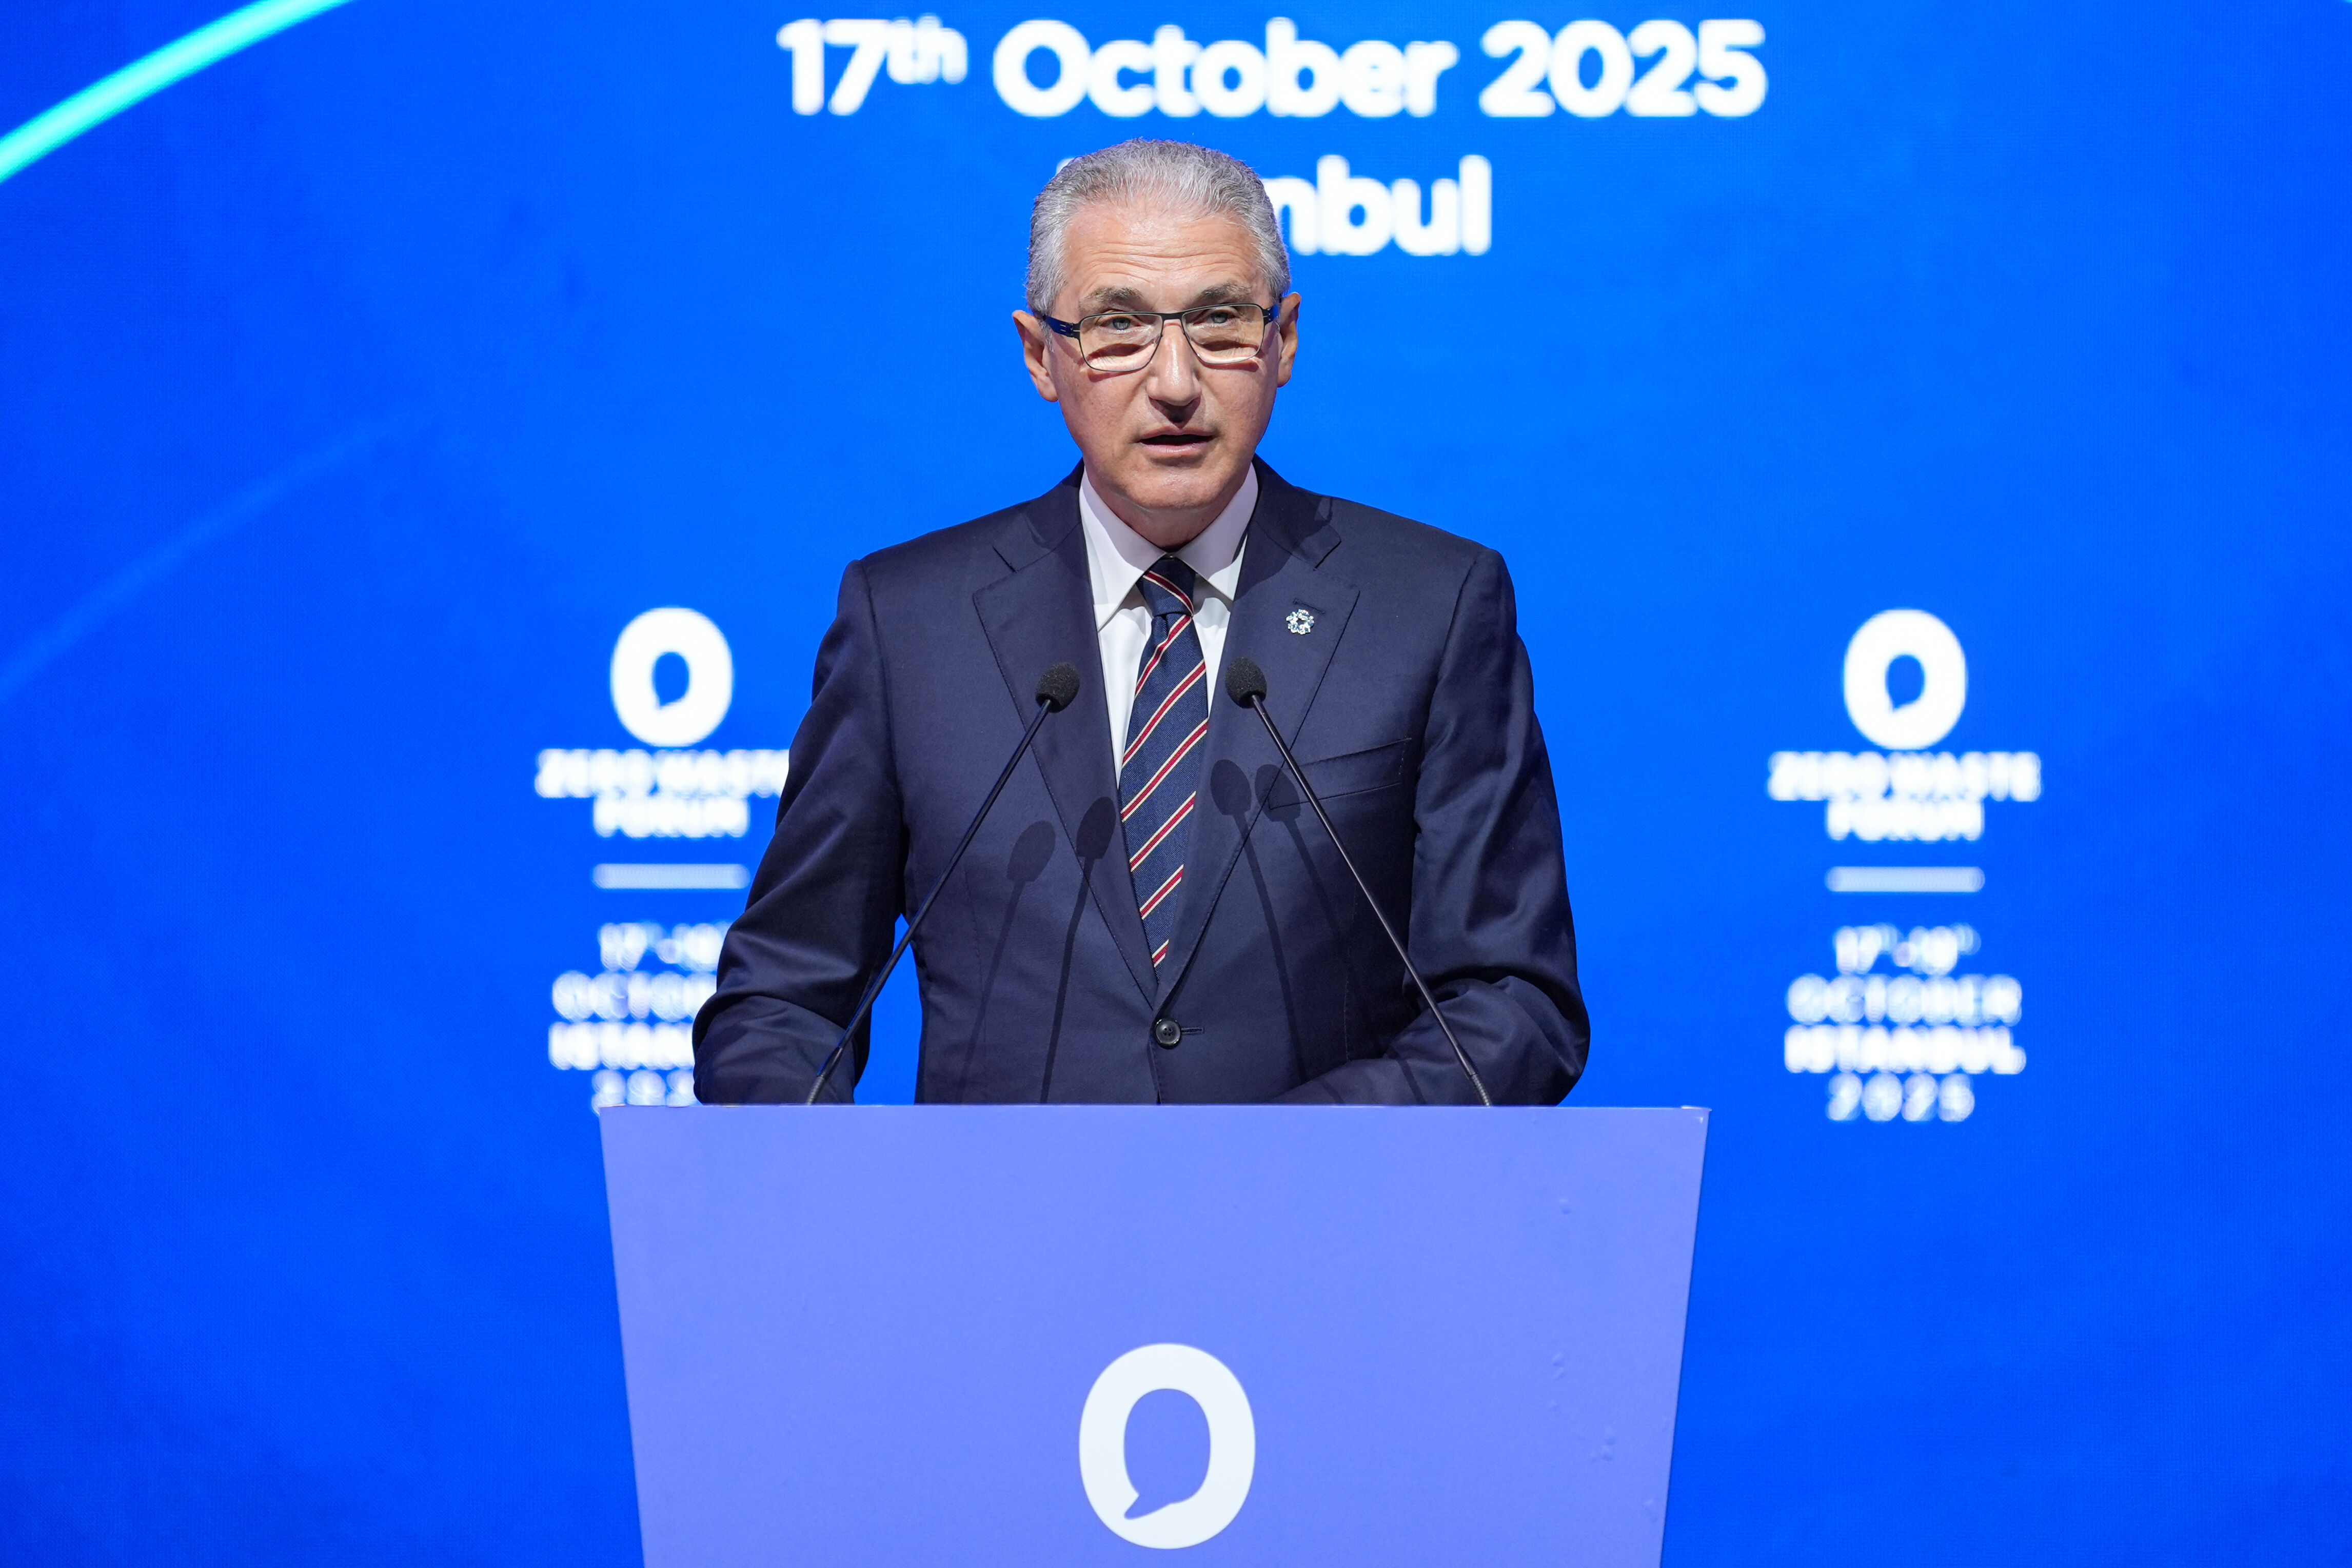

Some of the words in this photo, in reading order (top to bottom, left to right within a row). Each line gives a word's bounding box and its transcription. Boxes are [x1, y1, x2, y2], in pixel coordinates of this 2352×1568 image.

[777, 15, 967, 115] 17th
[993, 17, 1458, 117] October
[1479, 19, 1767, 117] 2025
